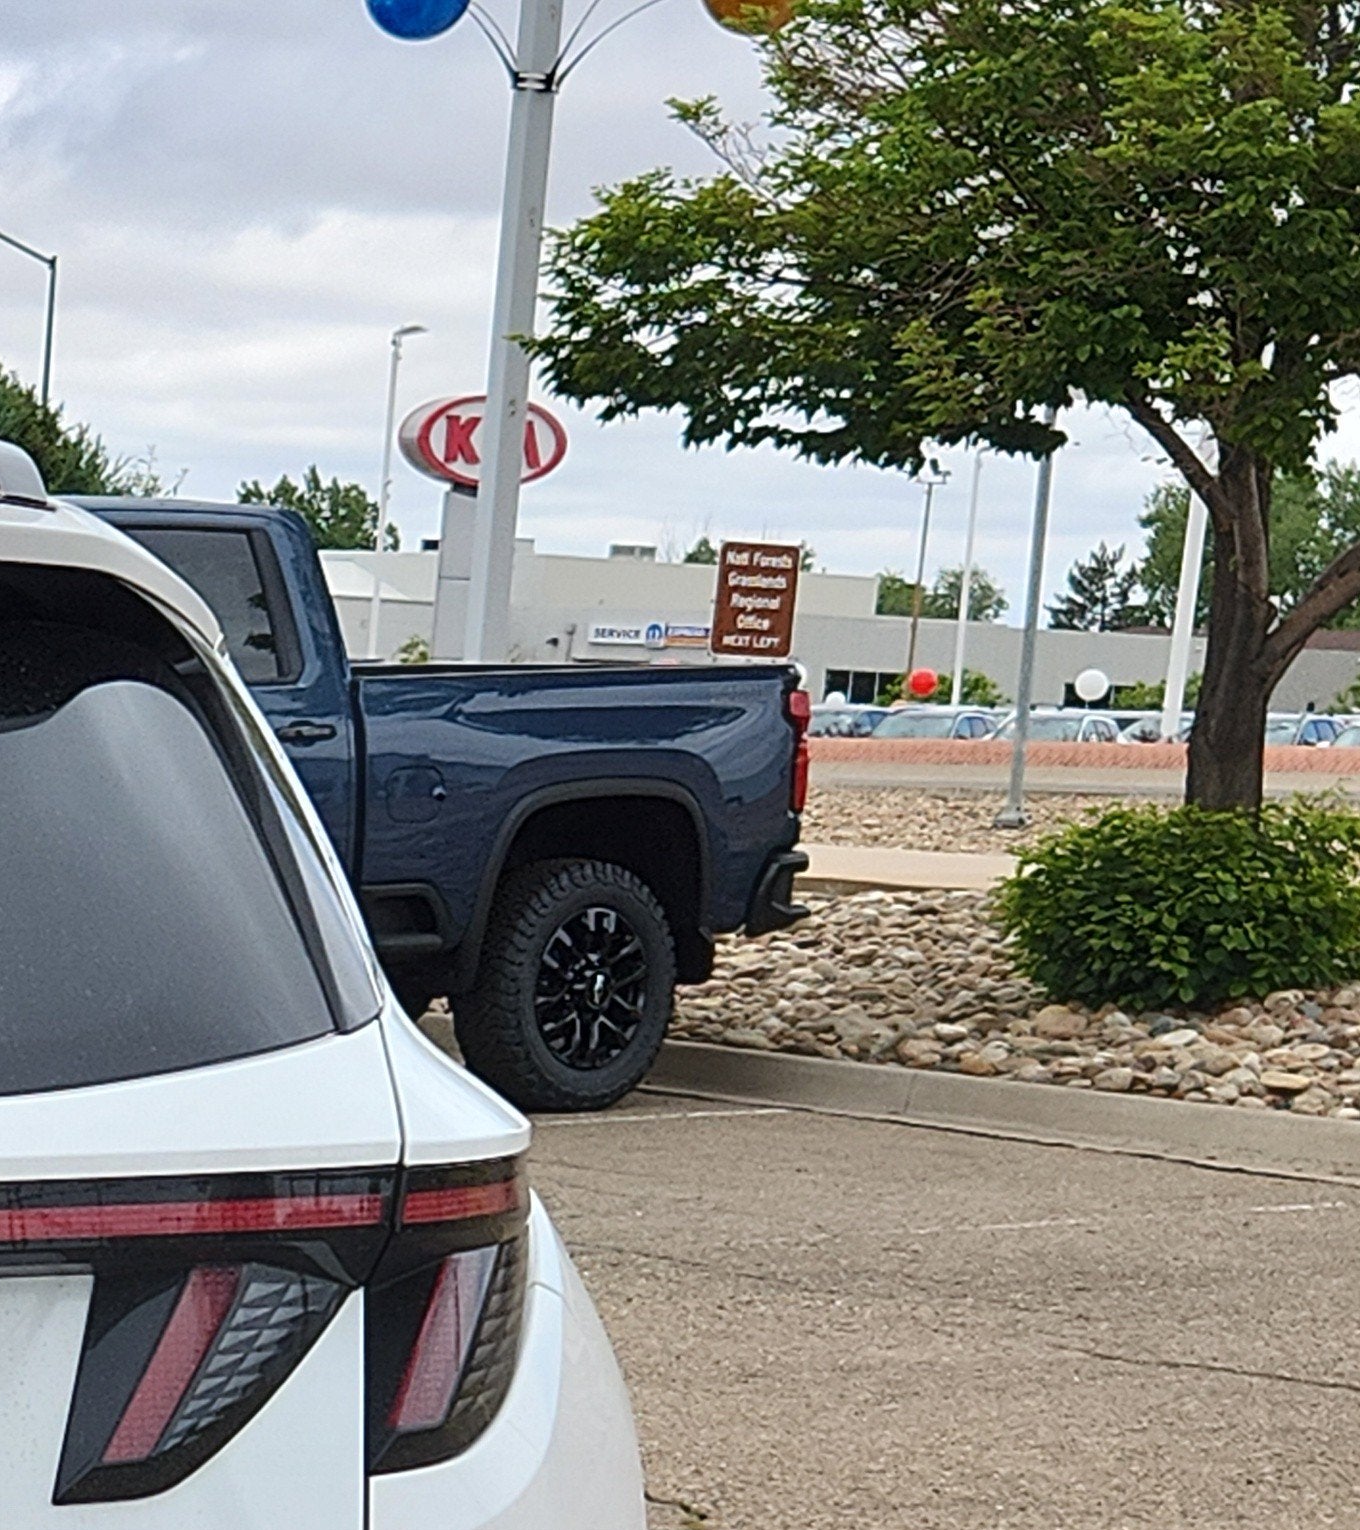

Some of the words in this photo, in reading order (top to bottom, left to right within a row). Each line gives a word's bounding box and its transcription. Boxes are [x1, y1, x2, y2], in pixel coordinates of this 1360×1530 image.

[594, 627, 641, 640] SERVICE
[722, 635, 751, 647] NEXT
[752, 635, 781, 648] LEFT
